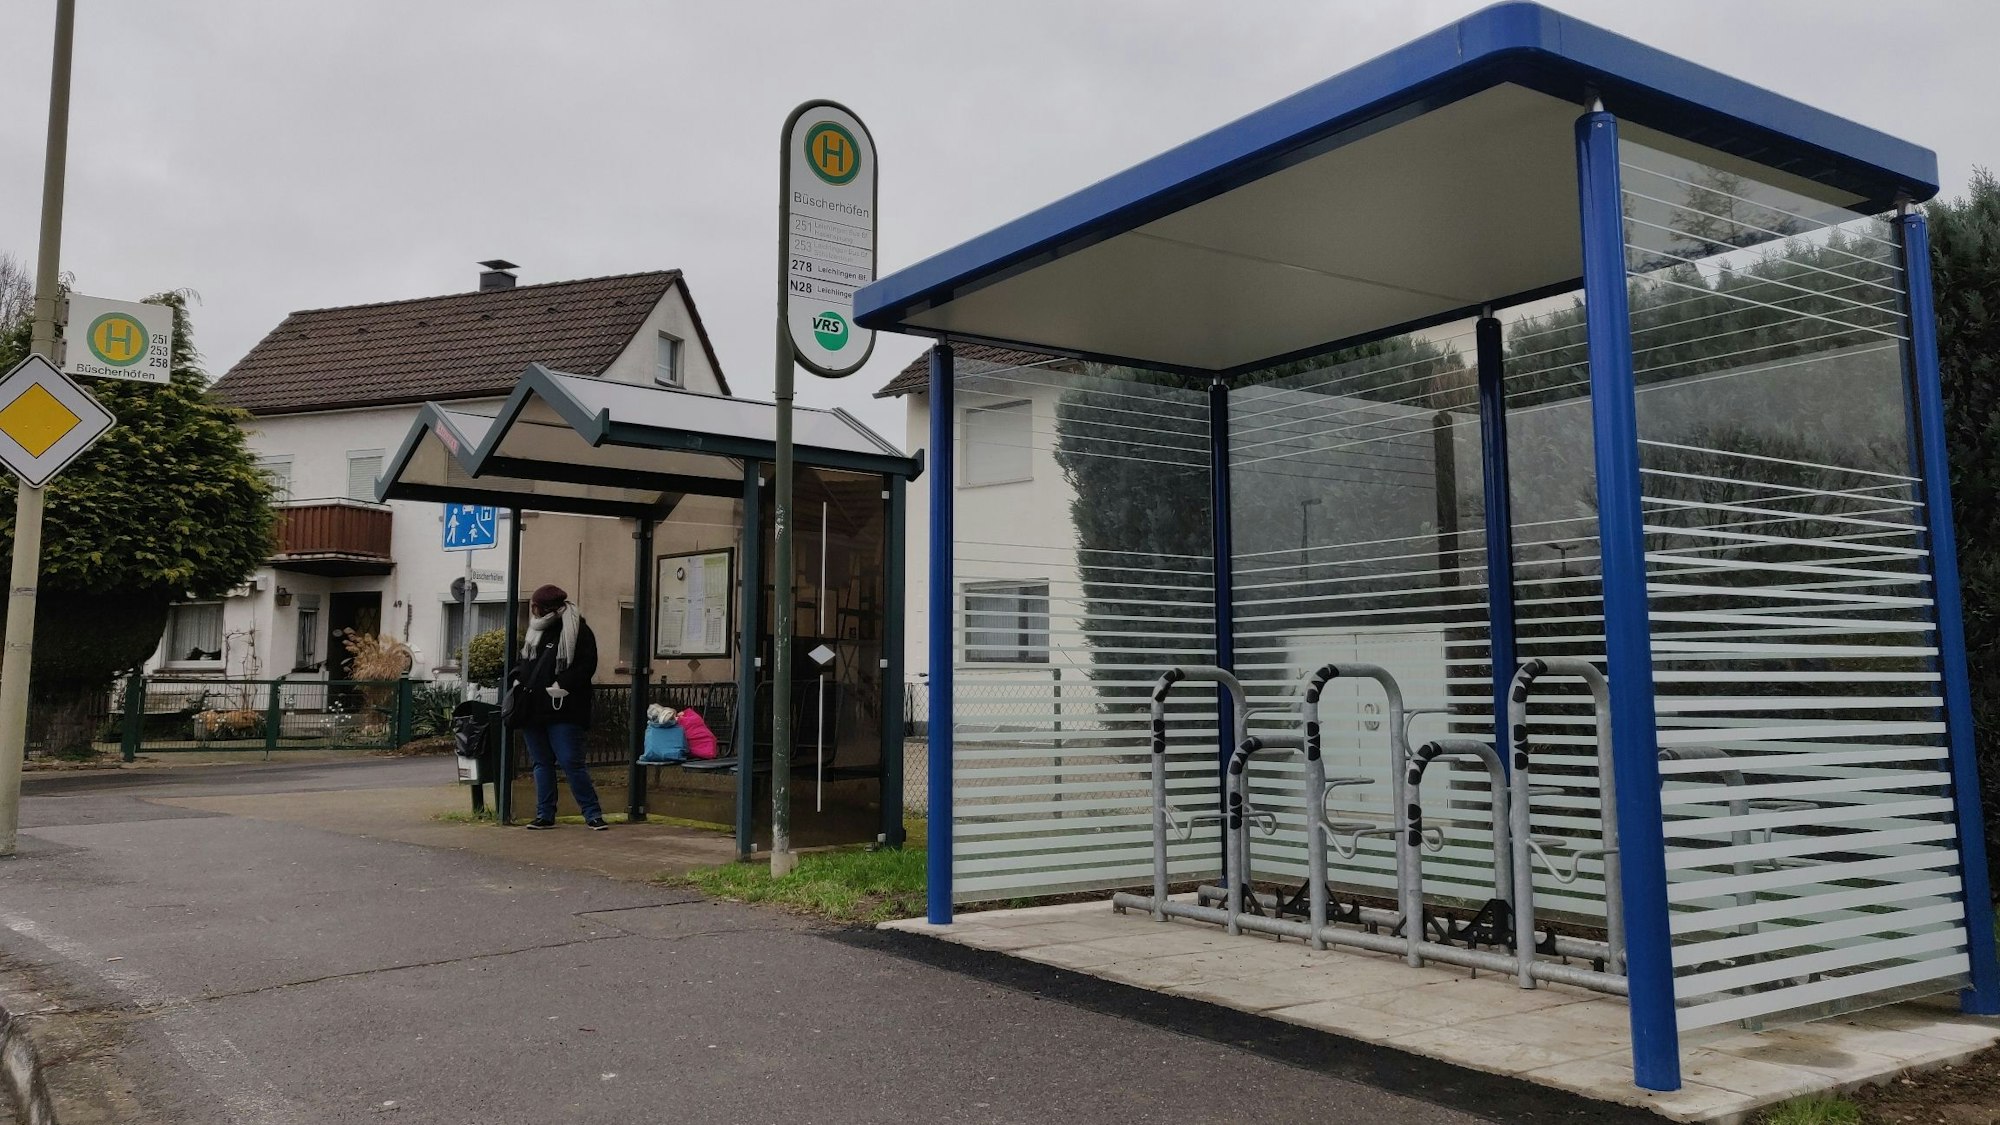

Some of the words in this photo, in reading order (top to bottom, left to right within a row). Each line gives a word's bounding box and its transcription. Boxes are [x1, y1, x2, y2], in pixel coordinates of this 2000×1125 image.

[794, 192, 869, 218] Büscherhöfen
[795, 220, 812, 233] 251
[794, 239, 812, 252] 253
[792, 260, 812, 272] 278
[818, 266, 856, 280] Leichlingen
[790, 280, 812, 294] N28
[818, 286, 852, 298] Leichlinge
[812, 317, 840, 333] VRS
[152, 334, 168, 344] 251
[150, 346, 168, 356] 253
[149, 357, 168, 368] 258
[76, 363, 156, 380] Büscherhöfen
